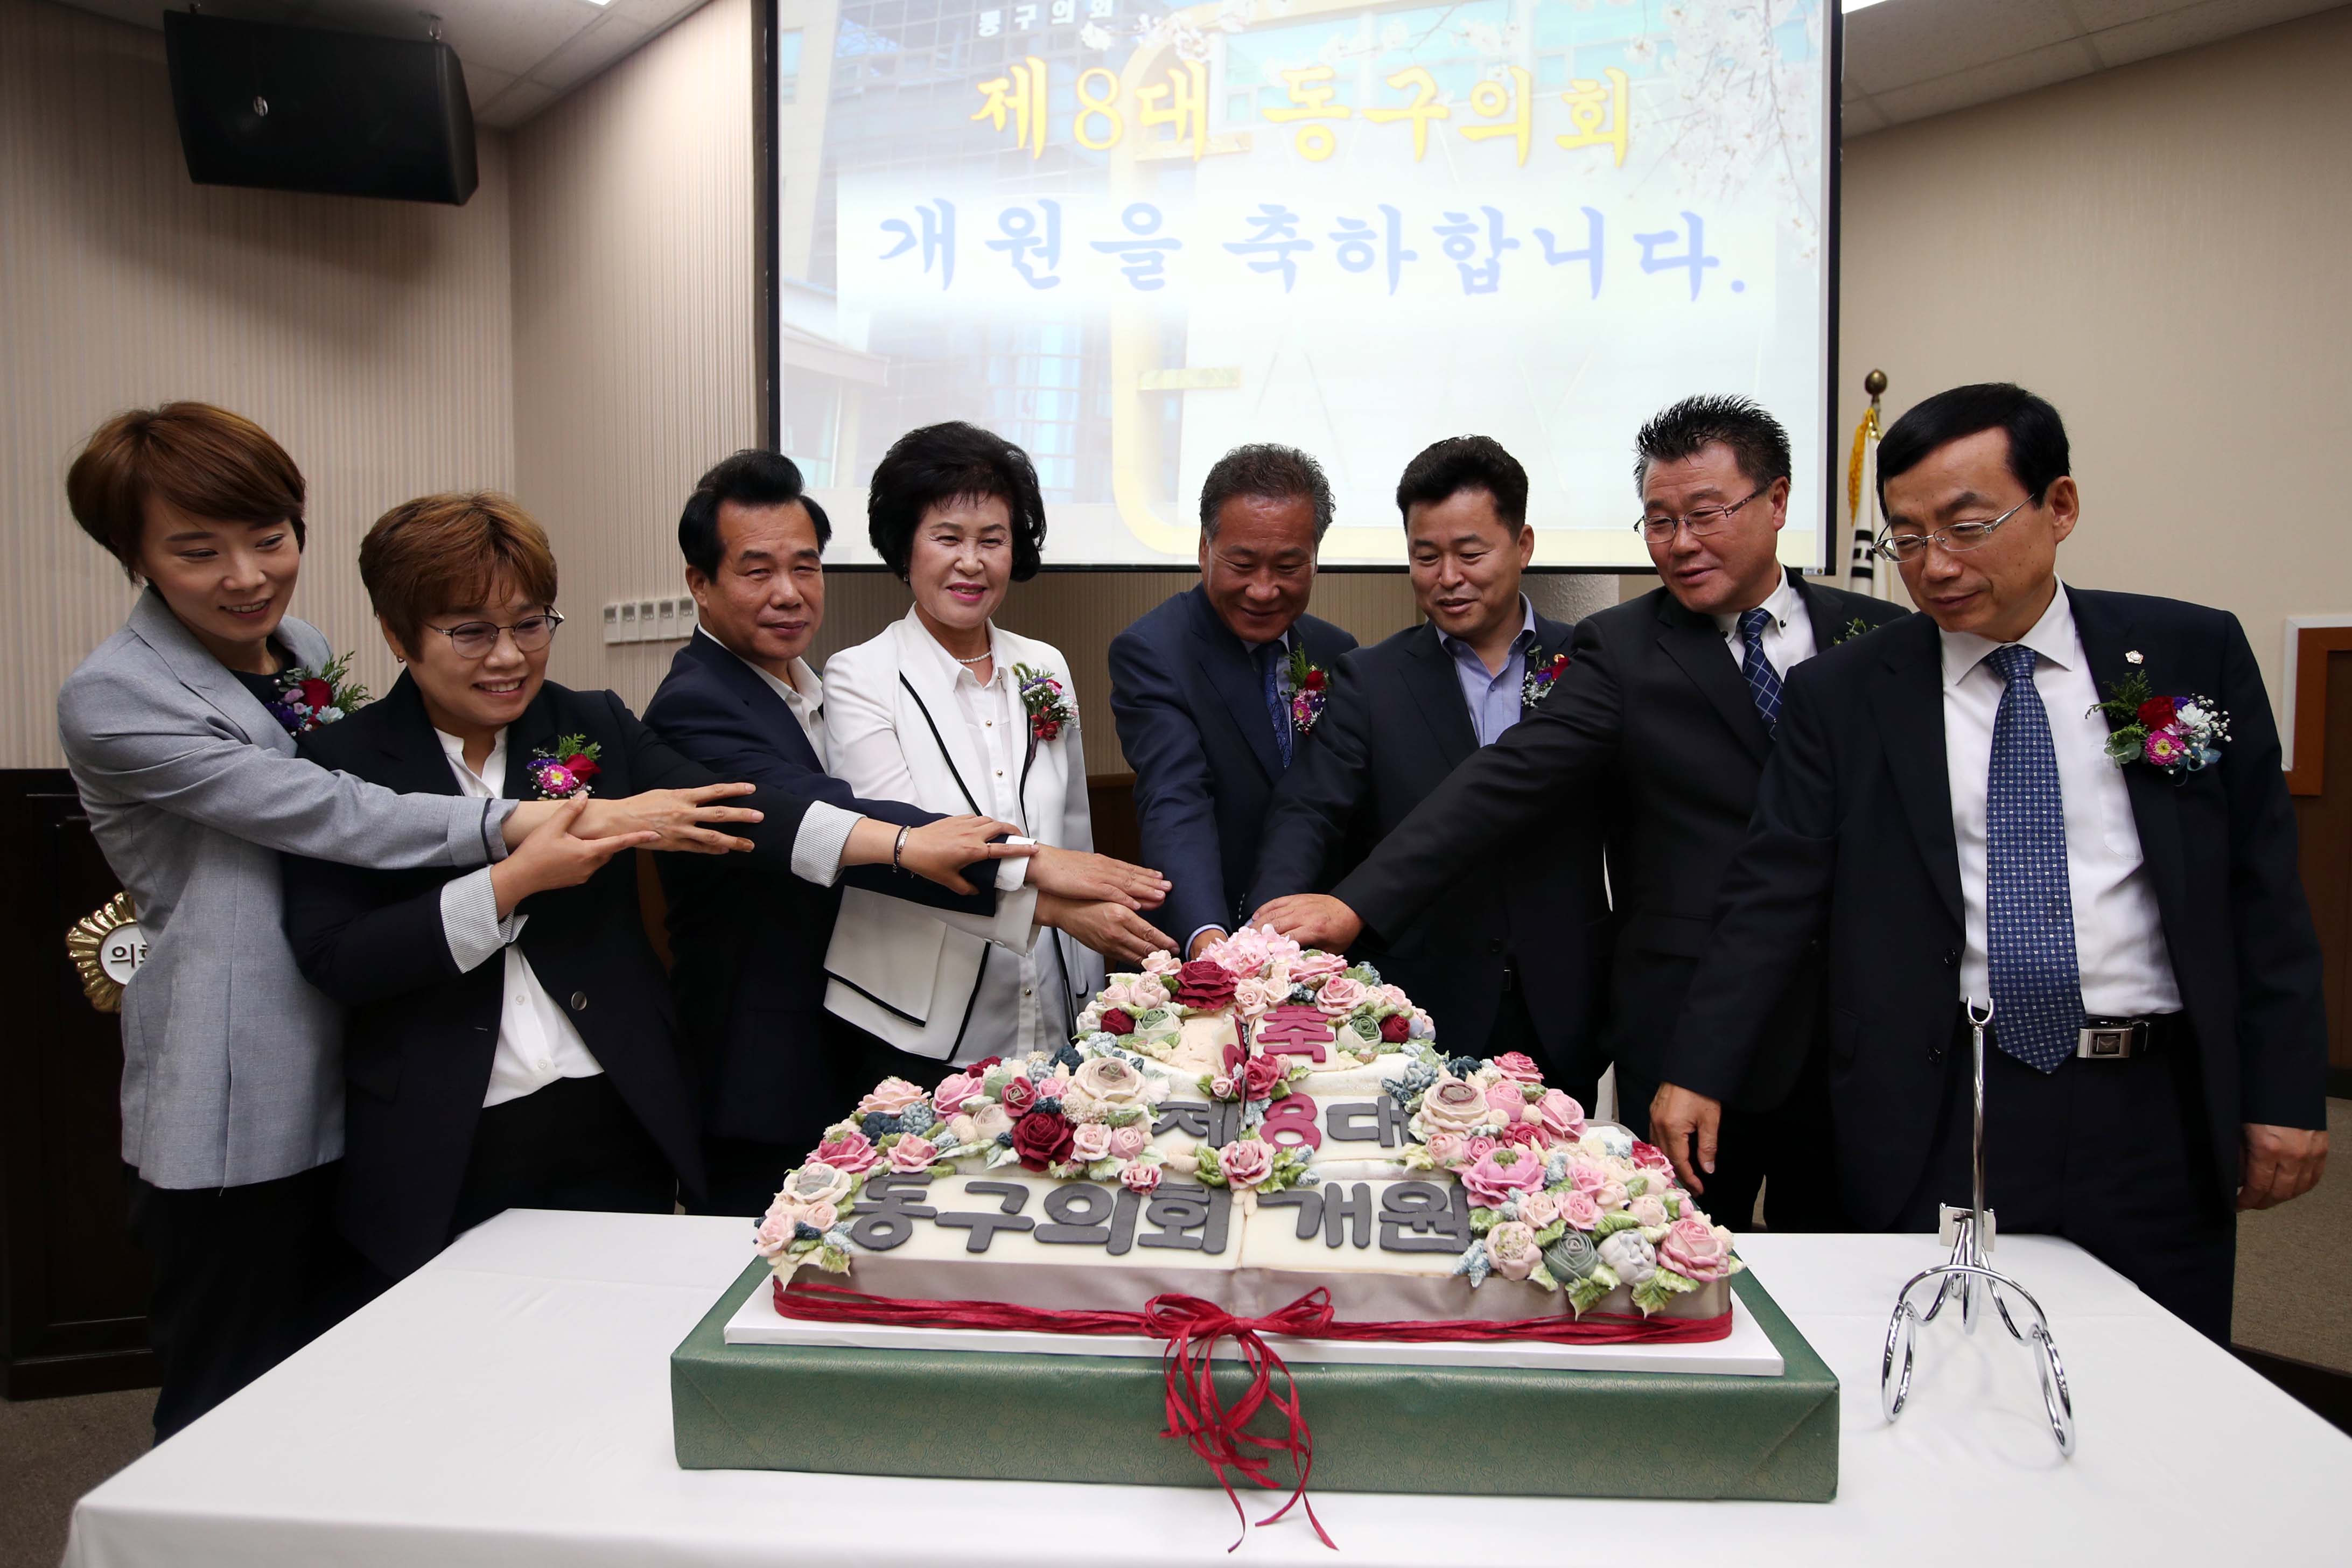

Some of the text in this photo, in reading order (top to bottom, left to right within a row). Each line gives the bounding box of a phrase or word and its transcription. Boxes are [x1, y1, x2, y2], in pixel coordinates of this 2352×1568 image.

[971, 56, 1631, 169] 제8대 동구의회
[879, 197, 1746, 303] 개원을 축하합니다.
[1256, 1005, 1334, 1063] 축
[1151, 1091, 1416, 1153] 제8대
[851, 1173, 1473, 1256] 동구의회 개원
